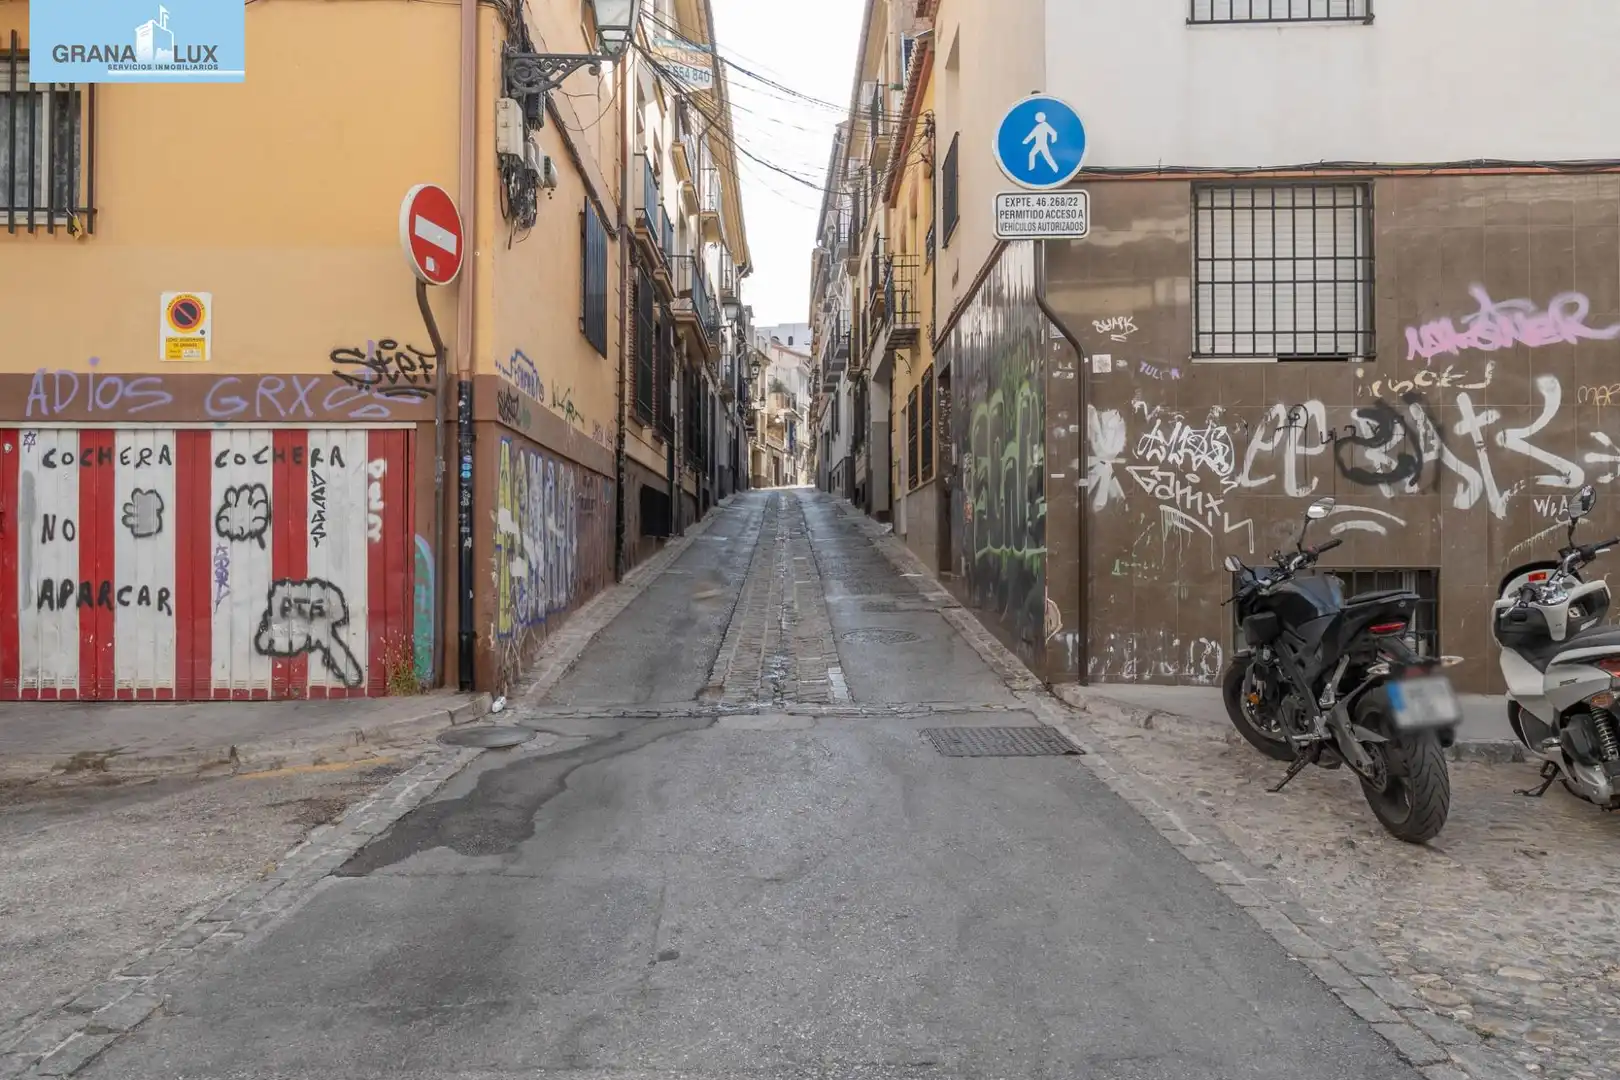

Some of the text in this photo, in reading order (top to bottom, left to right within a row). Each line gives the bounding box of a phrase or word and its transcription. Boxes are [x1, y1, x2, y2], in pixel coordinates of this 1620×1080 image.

[1005, 196, 1079, 208] EXPTE. 46.268/22
[999, 209, 1084, 220] PERMITIDO ACCESO A
[1037, 221, 1084, 232] AUTORIZADOS
[42, 445, 346, 469] COCHERA COCHERA
[41, 514, 76, 545] NO
[37, 578, 172, 617] APARCAR
